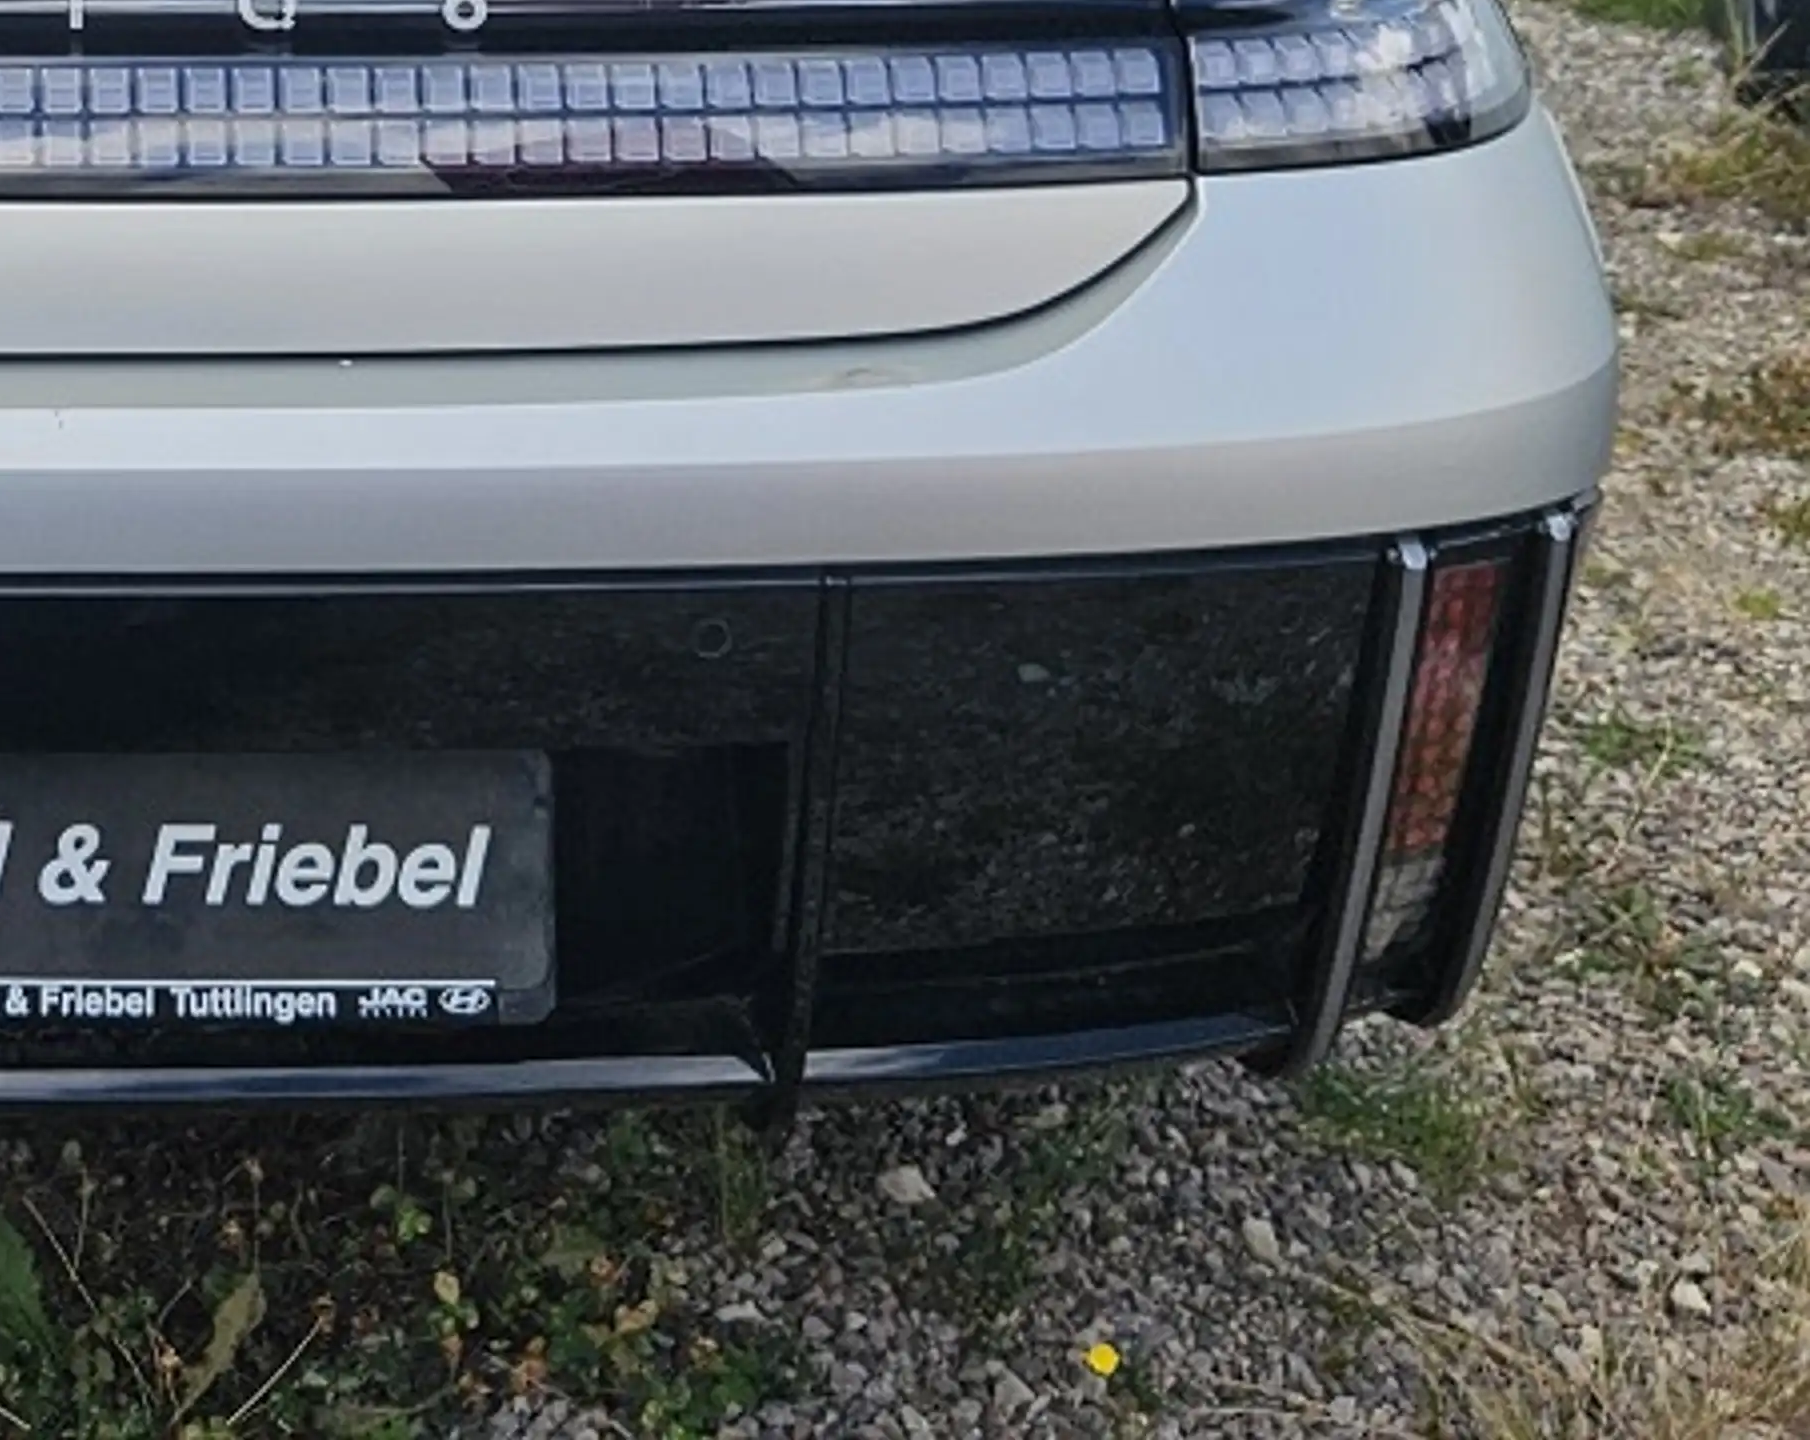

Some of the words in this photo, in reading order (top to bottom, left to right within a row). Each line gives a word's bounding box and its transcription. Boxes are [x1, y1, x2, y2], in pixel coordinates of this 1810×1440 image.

[39, 823, 111, 905] &
[142, 823, 491, 908] Friebel
[5, 984, 29, 1016] &
[40, 985, 154, 1017] Friebel
[171, 987, 337, 1023] Tuttlingen
